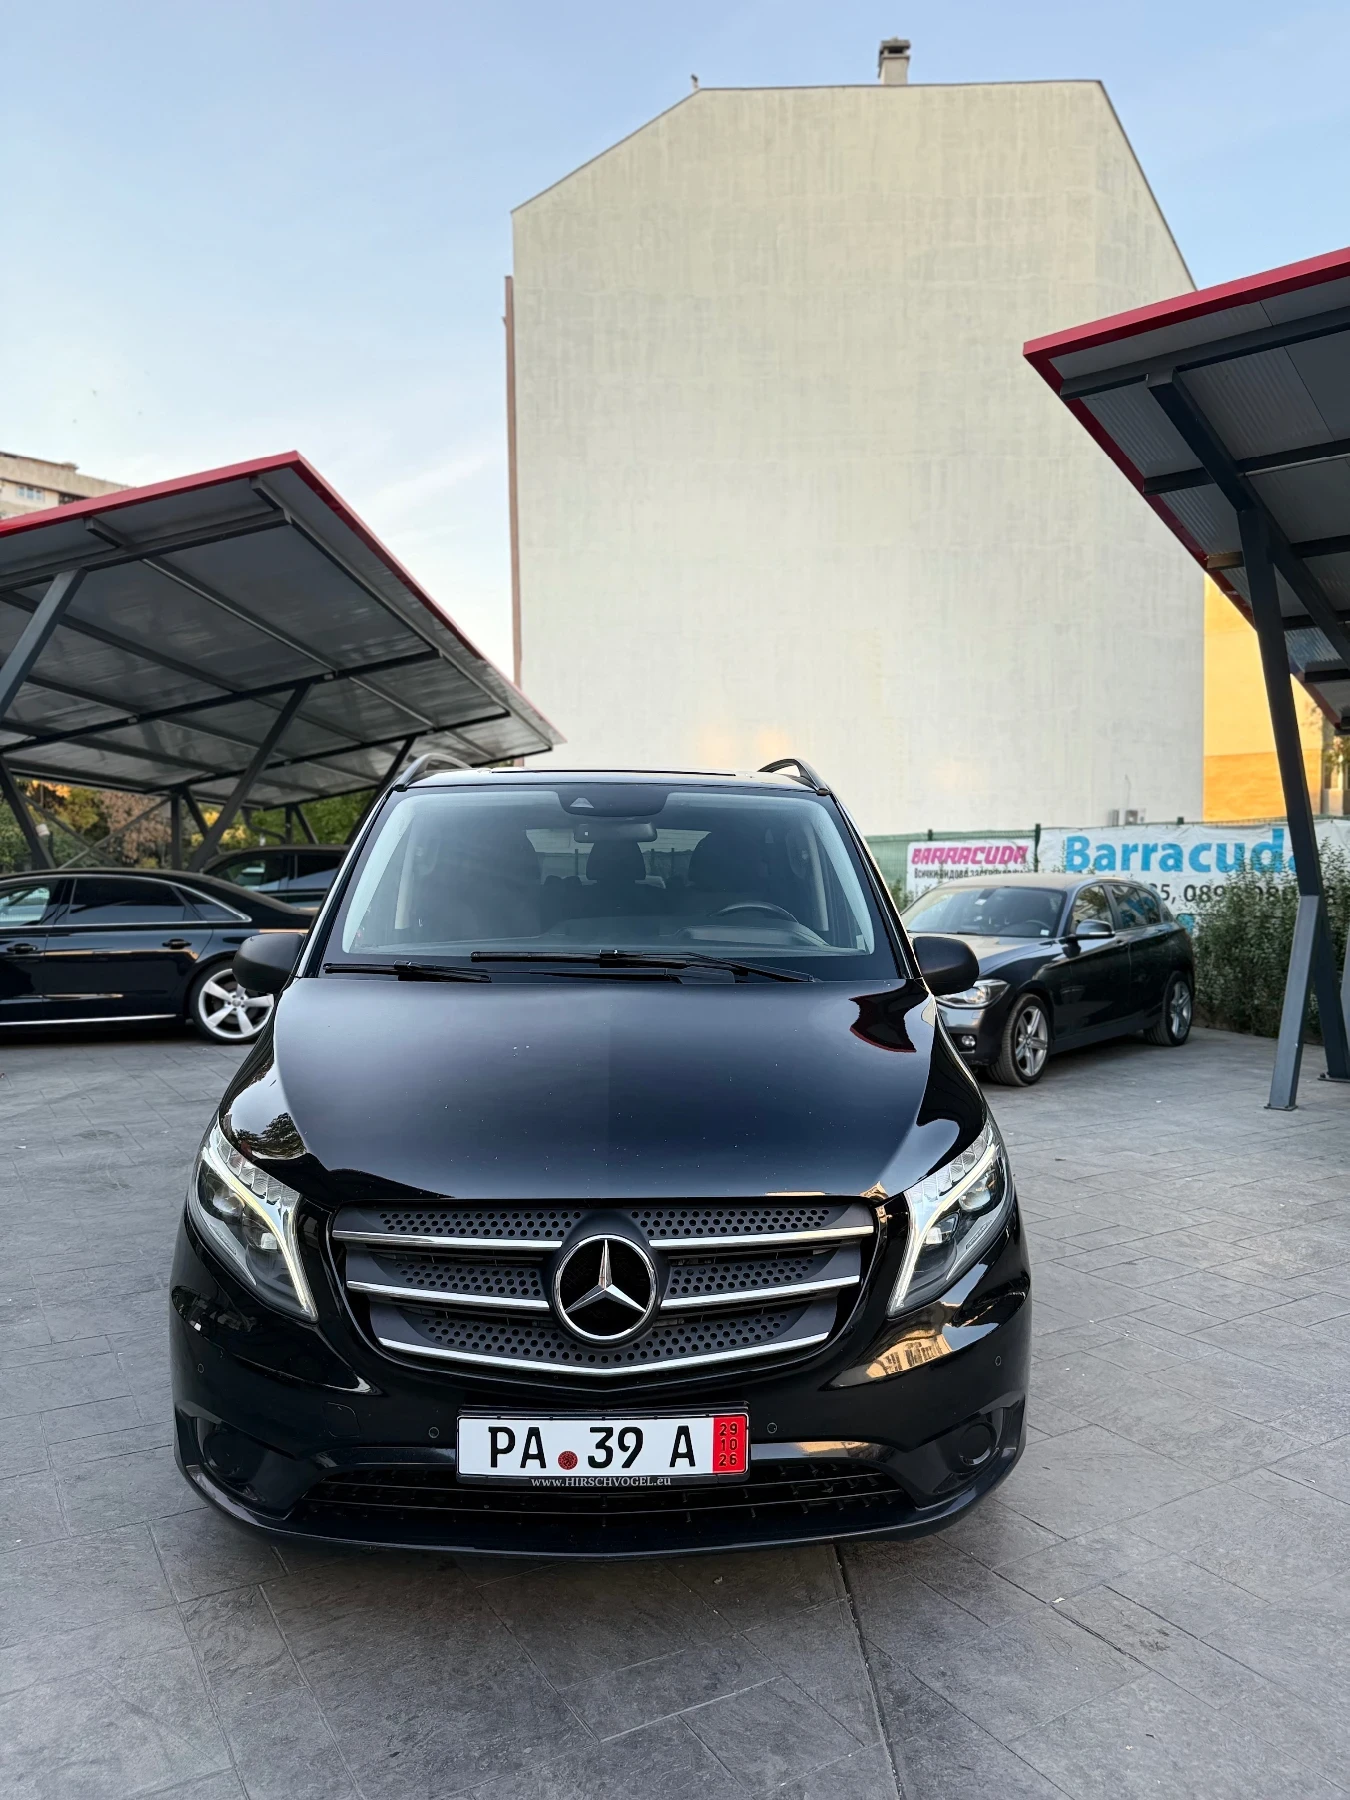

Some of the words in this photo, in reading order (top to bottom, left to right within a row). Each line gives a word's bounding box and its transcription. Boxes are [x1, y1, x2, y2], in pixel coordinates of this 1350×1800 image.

[911, 845, 1029, 865] BARRACUDA
[1065, 828, 1296, 873] Barracud
[719, 1422, 738, 1436] 29
[488, 1426, 547, 1468] PA
[587, 1426, 644, 1468] 39
[669, 1425, 696, 1467] A
[721, 1437, 738, 1451] 10
[719, 1452, 738, 1467] 26
[531, 1476, 672, 1487] www.HIRSCHVOGEL.eu
